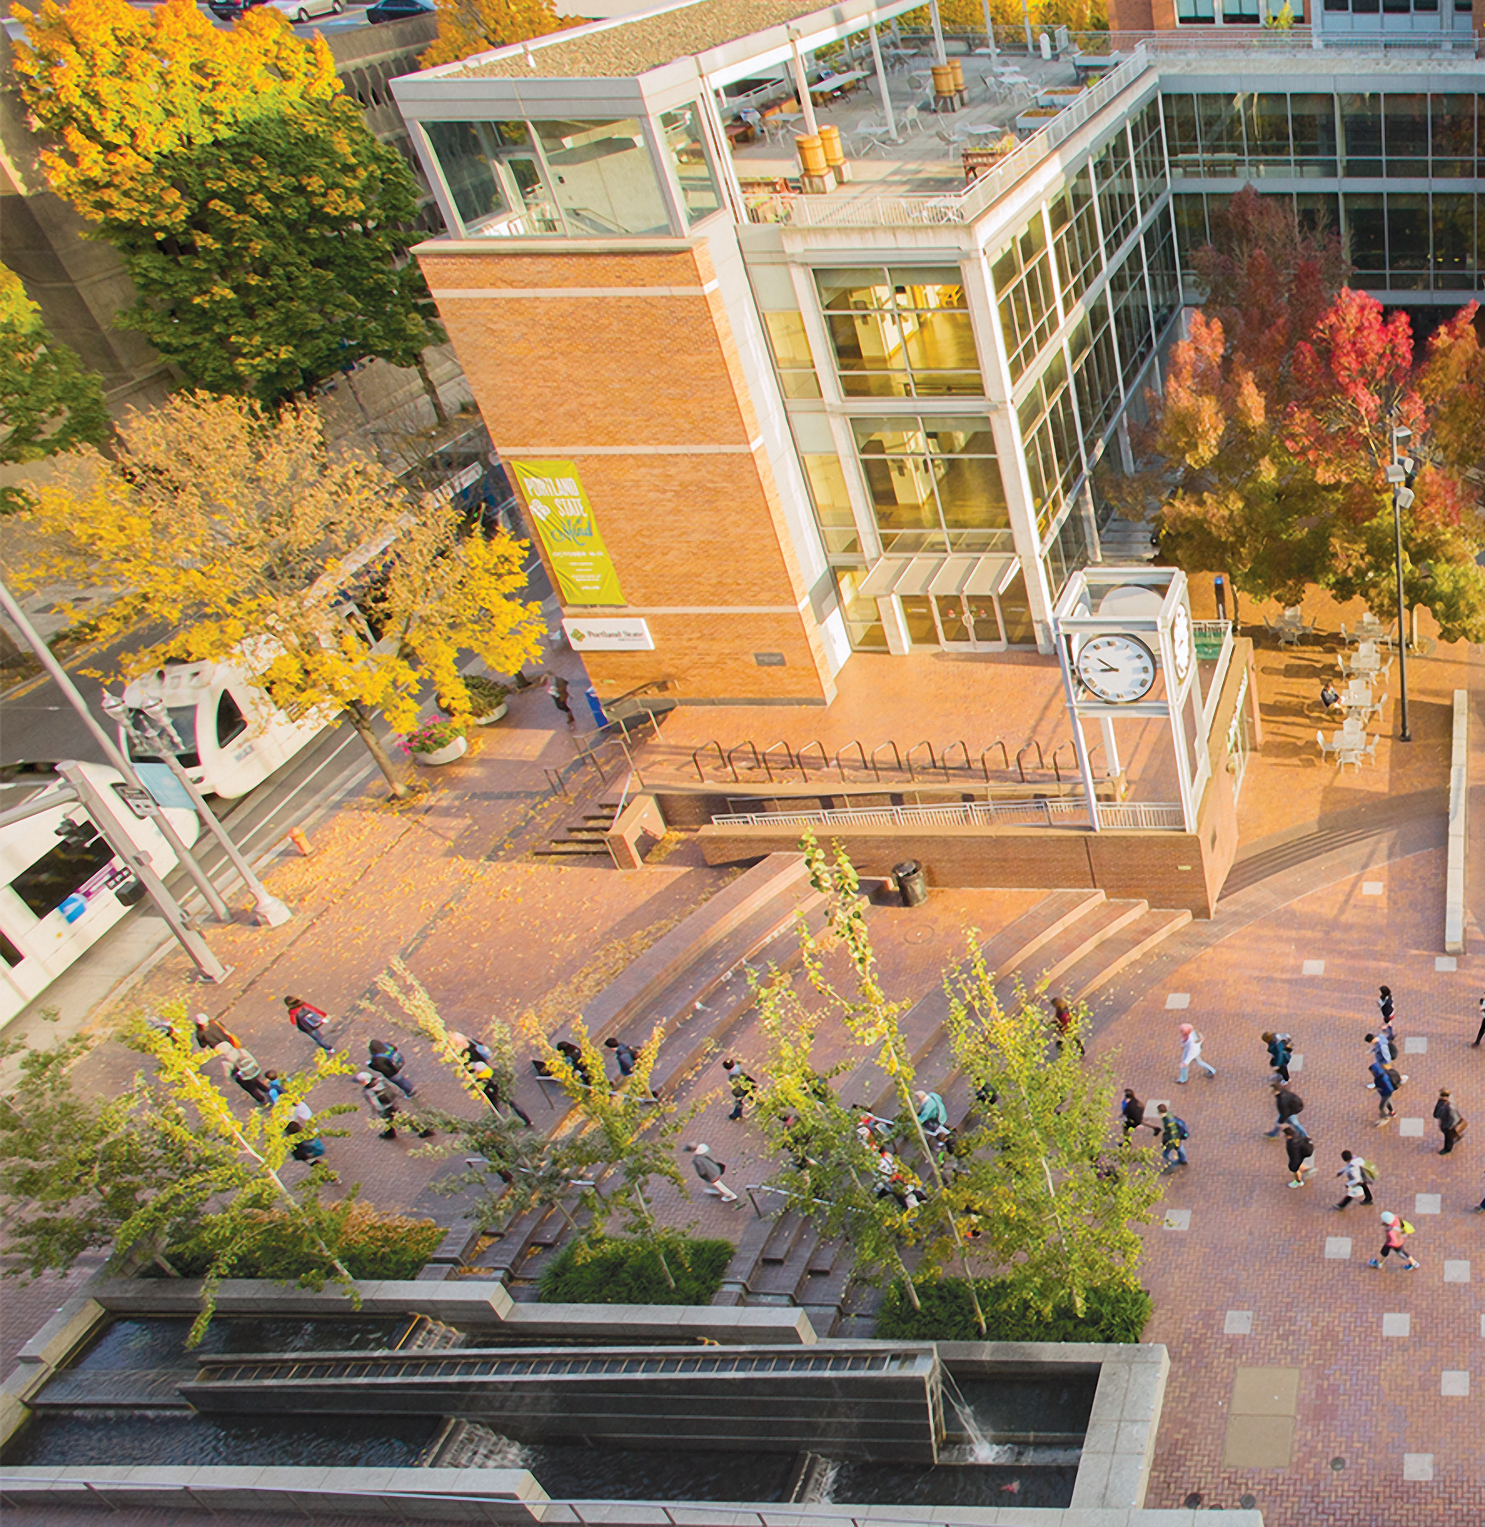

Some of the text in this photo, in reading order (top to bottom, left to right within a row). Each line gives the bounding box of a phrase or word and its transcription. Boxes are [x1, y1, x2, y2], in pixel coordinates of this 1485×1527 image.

[523, 477, 579, 496] PORTLAND
[554, 498, 587, 517] STATE
[587, 630, 622, 638] Portland
